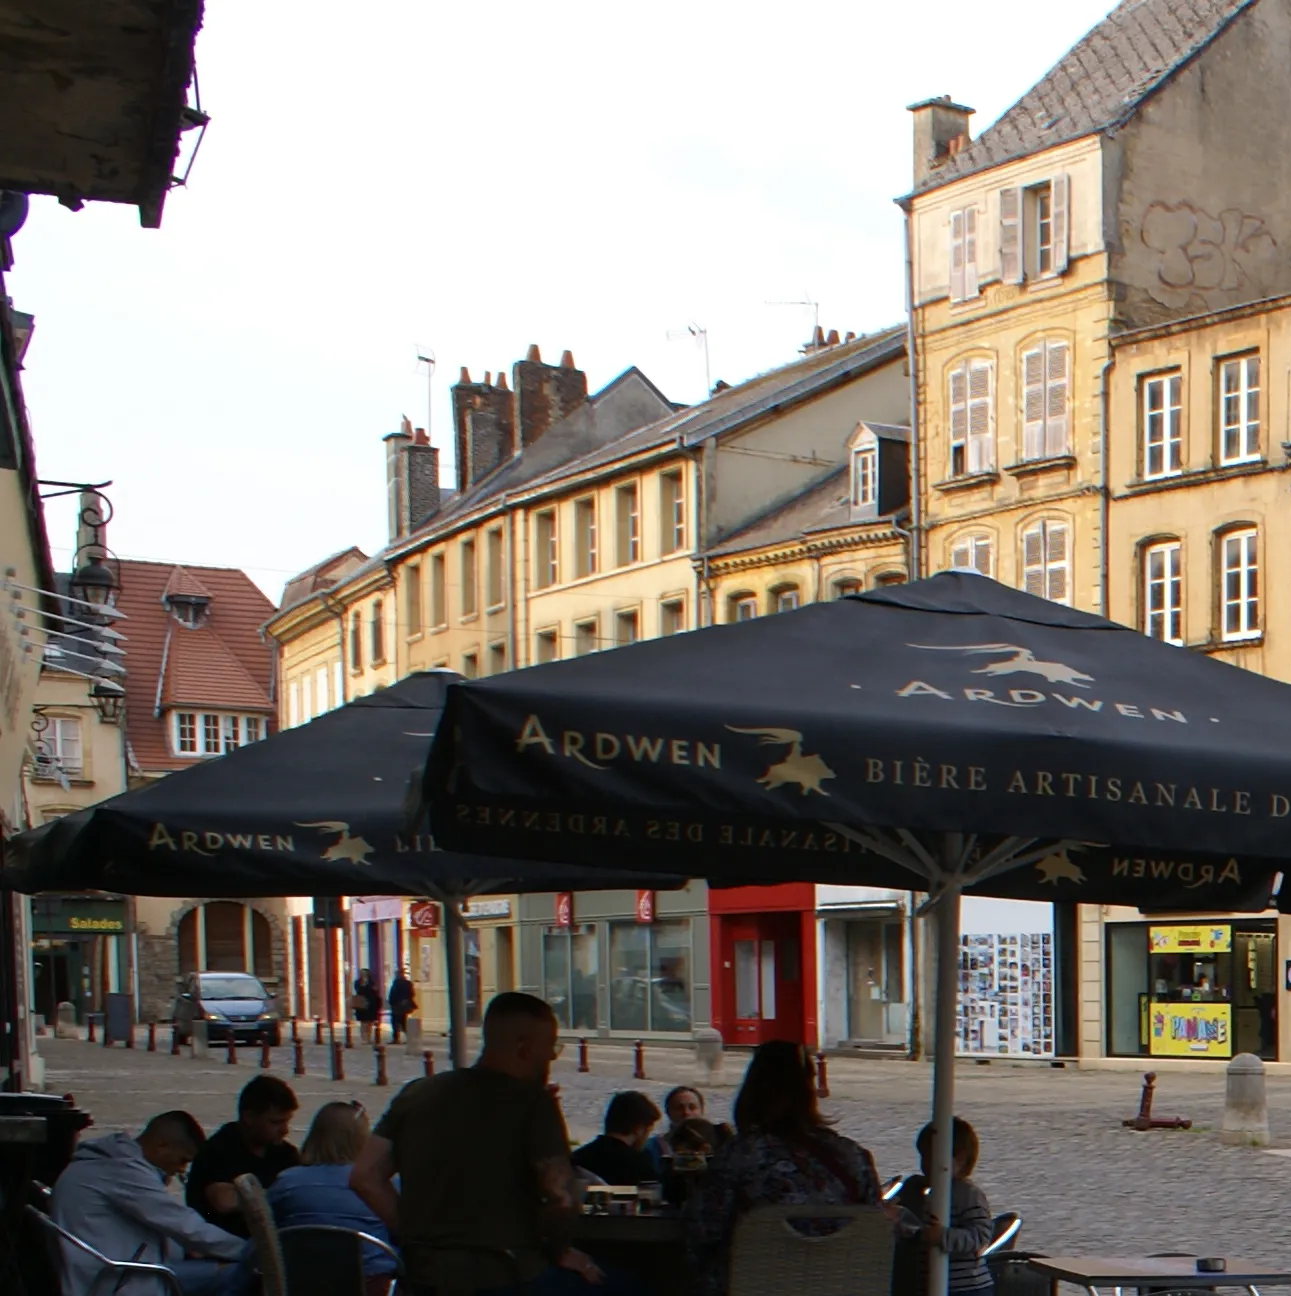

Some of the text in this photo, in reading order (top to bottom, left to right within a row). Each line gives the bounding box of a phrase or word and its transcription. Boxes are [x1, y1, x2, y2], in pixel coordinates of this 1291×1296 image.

[895, 681, 1188, 724] ARDWEN
[515, 714, 721, 770] ARDWEN
[866, 756, 987, 791] BIÈRE
[1006, 770, 1250, 815] ARTISANALE
[148, 822, 295, 857] ARDWEN
[70, 916, 122, 930] Salades
